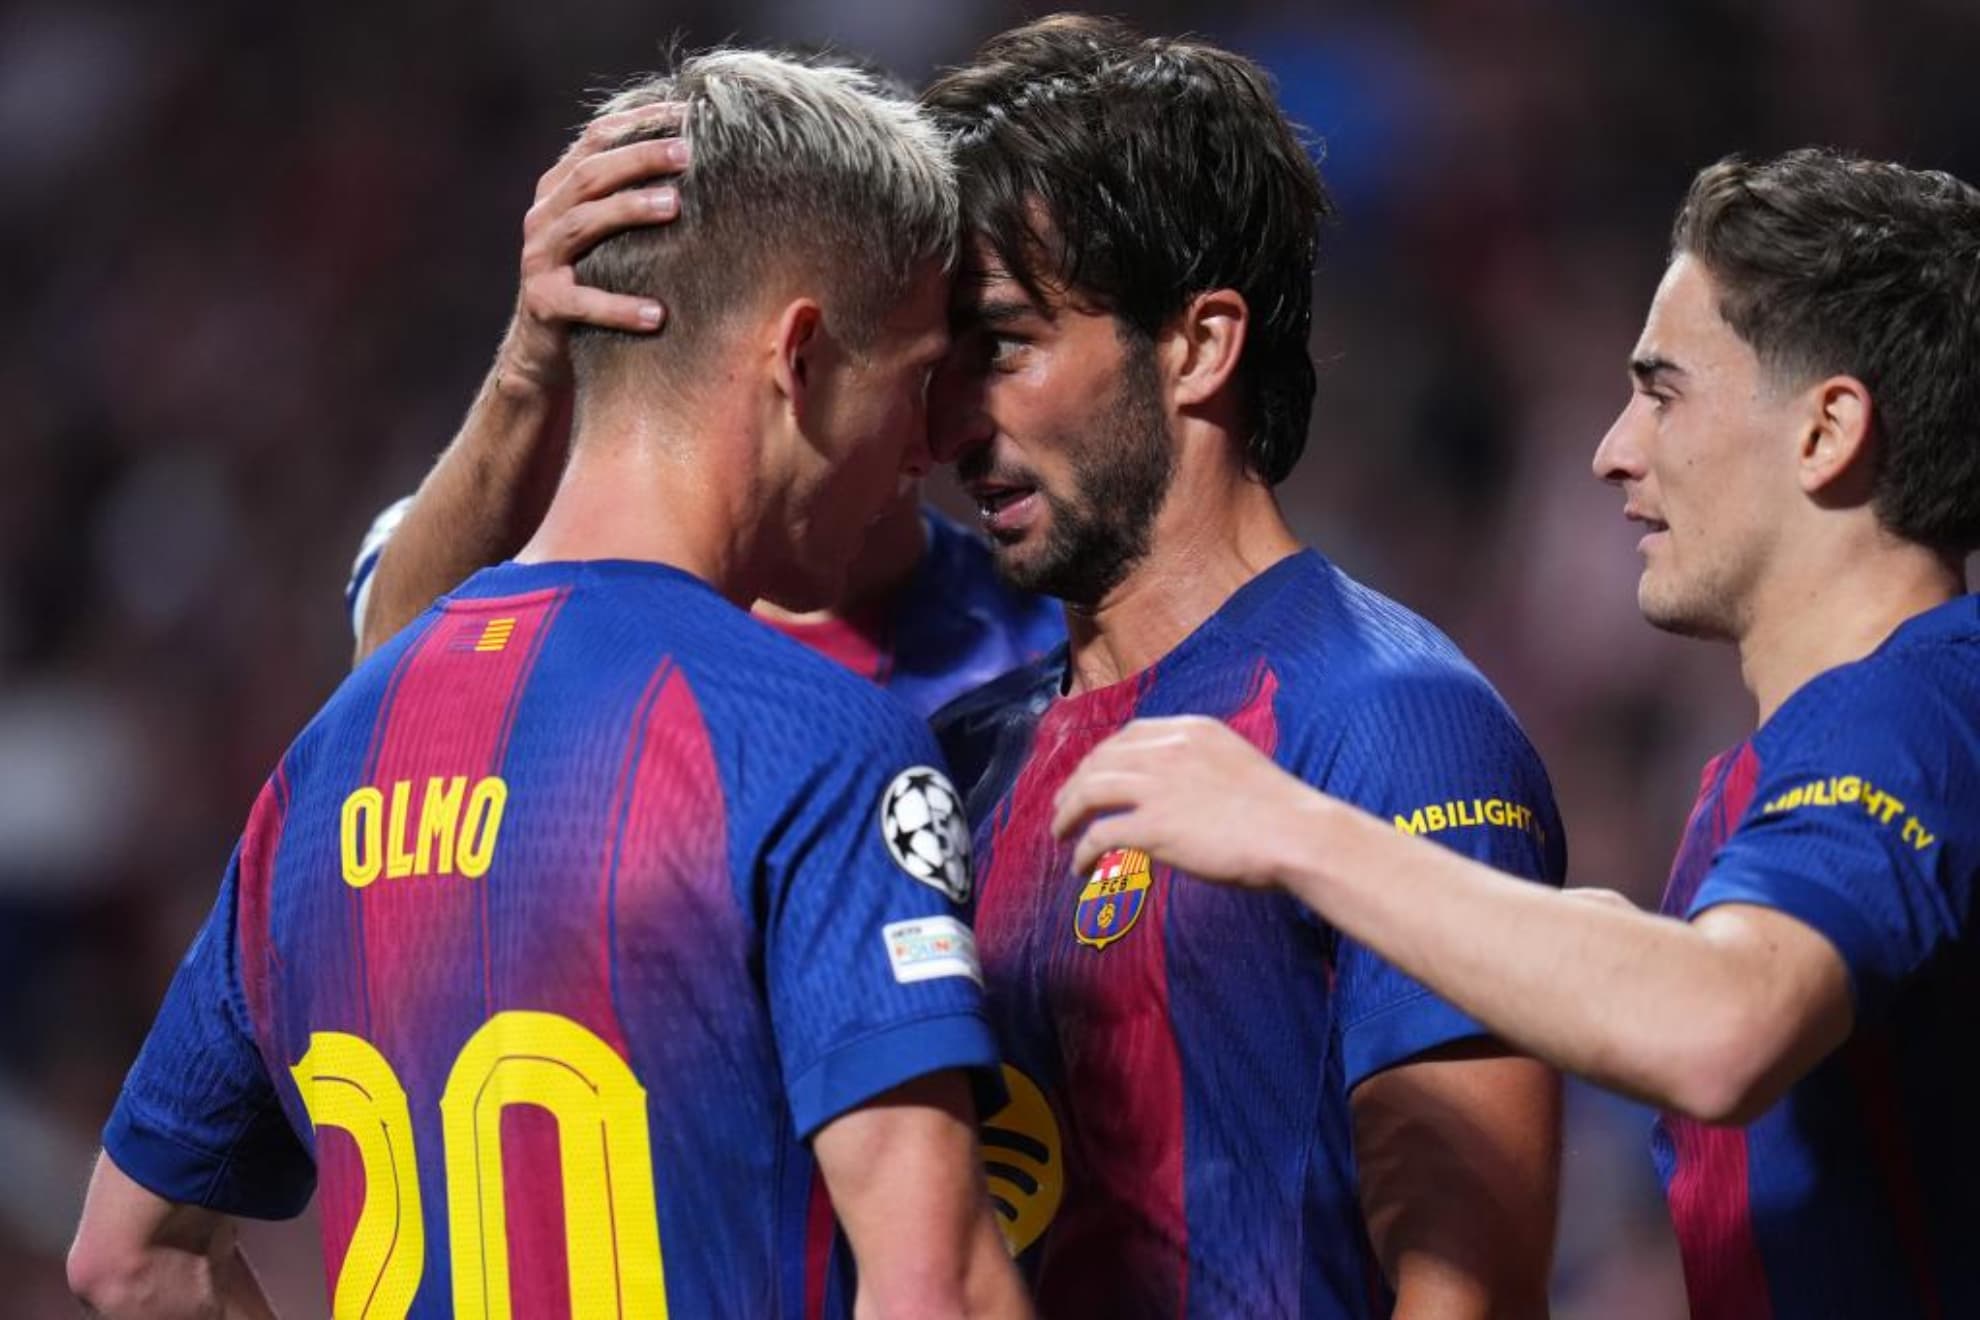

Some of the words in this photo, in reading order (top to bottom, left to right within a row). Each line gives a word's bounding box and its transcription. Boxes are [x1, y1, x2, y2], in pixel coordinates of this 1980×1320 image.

[341, 776, 508, 888] OLMO
[1394, 799, 1531, 836] MBILIGHT
[1101, 877, 1127, 895] FCB
[289, 1010, 669, 1320] 20
